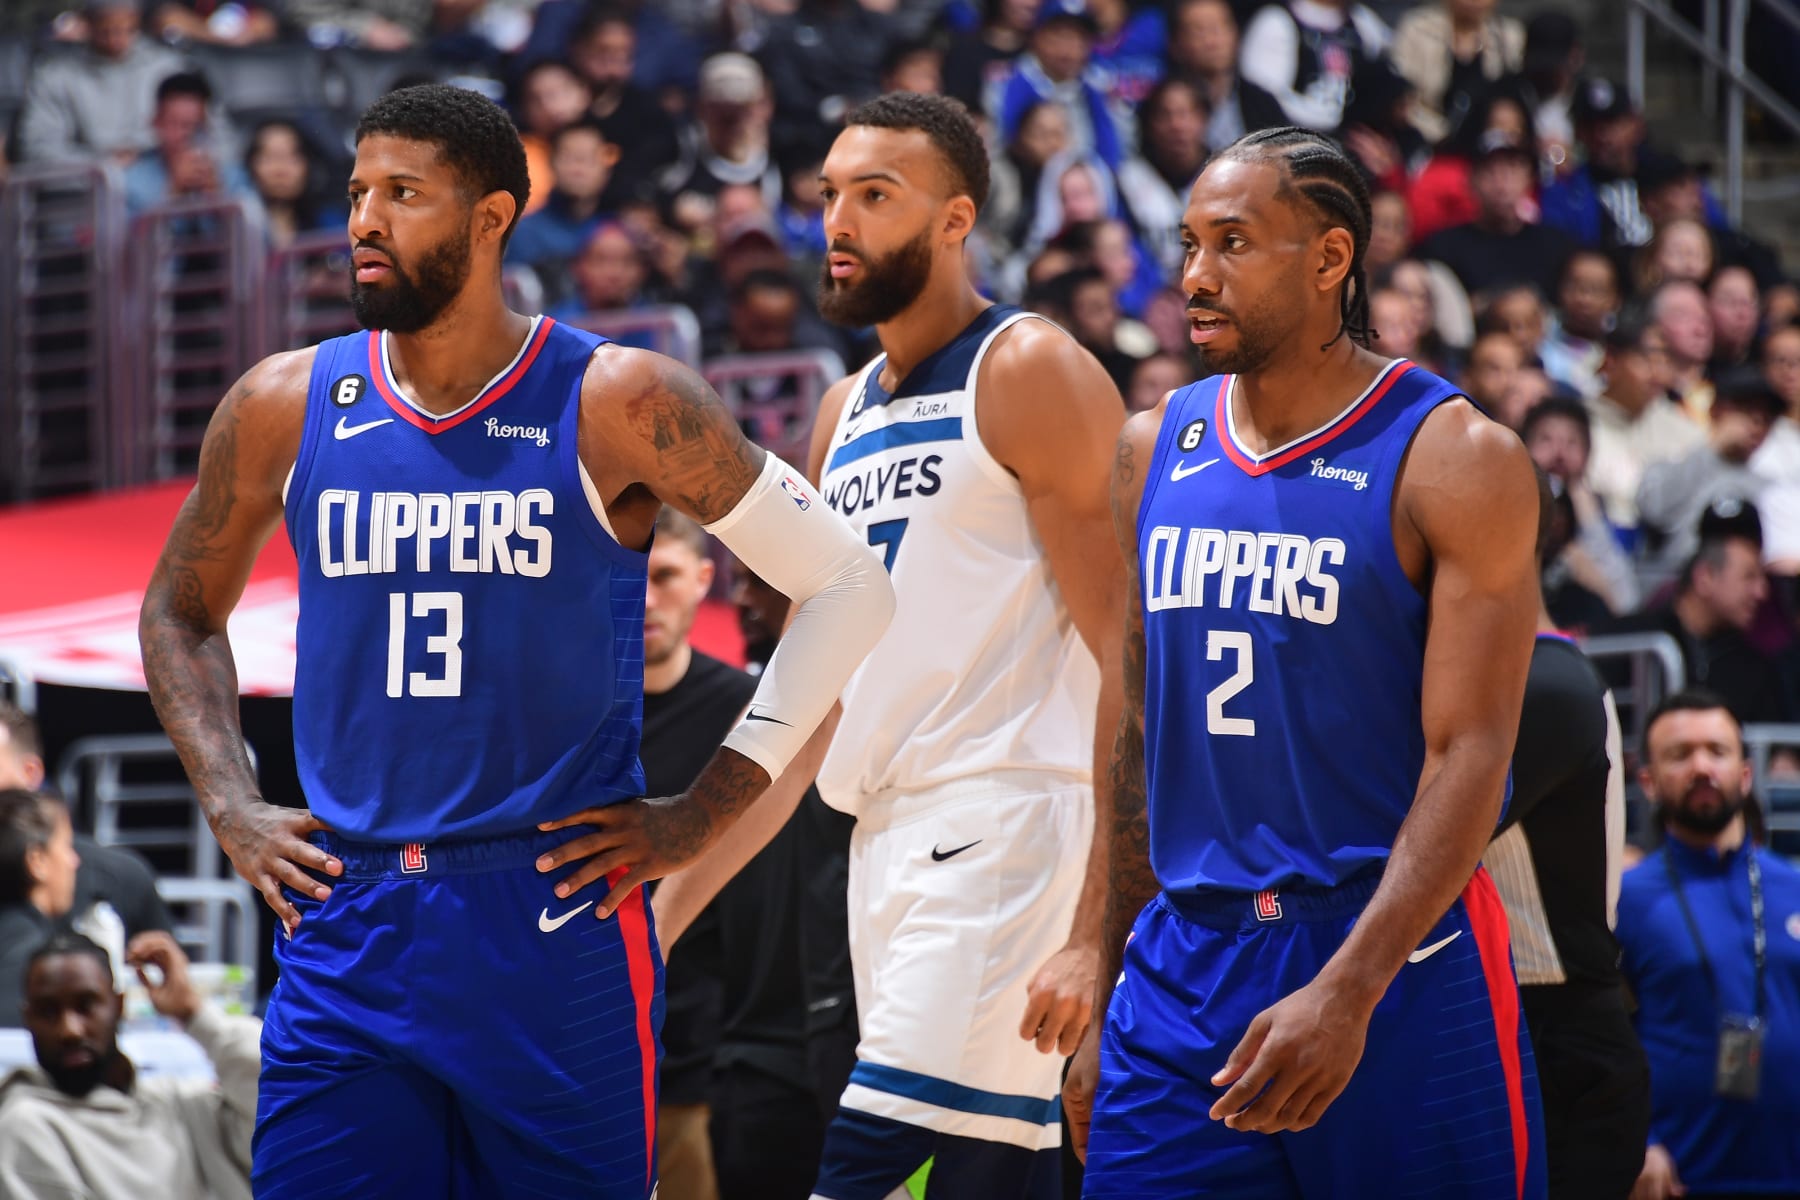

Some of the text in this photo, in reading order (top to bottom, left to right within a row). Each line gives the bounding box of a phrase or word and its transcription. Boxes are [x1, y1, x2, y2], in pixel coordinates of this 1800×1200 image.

[337, 377, 360, 404] 6
[484, 417, 550, 447] honey
[1182, 422, 1204, 449] 6
[824, 454, 943, 517] WOLVES
[1310, 457, 1368, 491] honey
[317, 488, 554, 578] CLIPPERS
[1146, 525, 1346, 625] CLIPPERS
[386, 591, 463, 698] 13
[1206, 630, 1256, 737] 2
